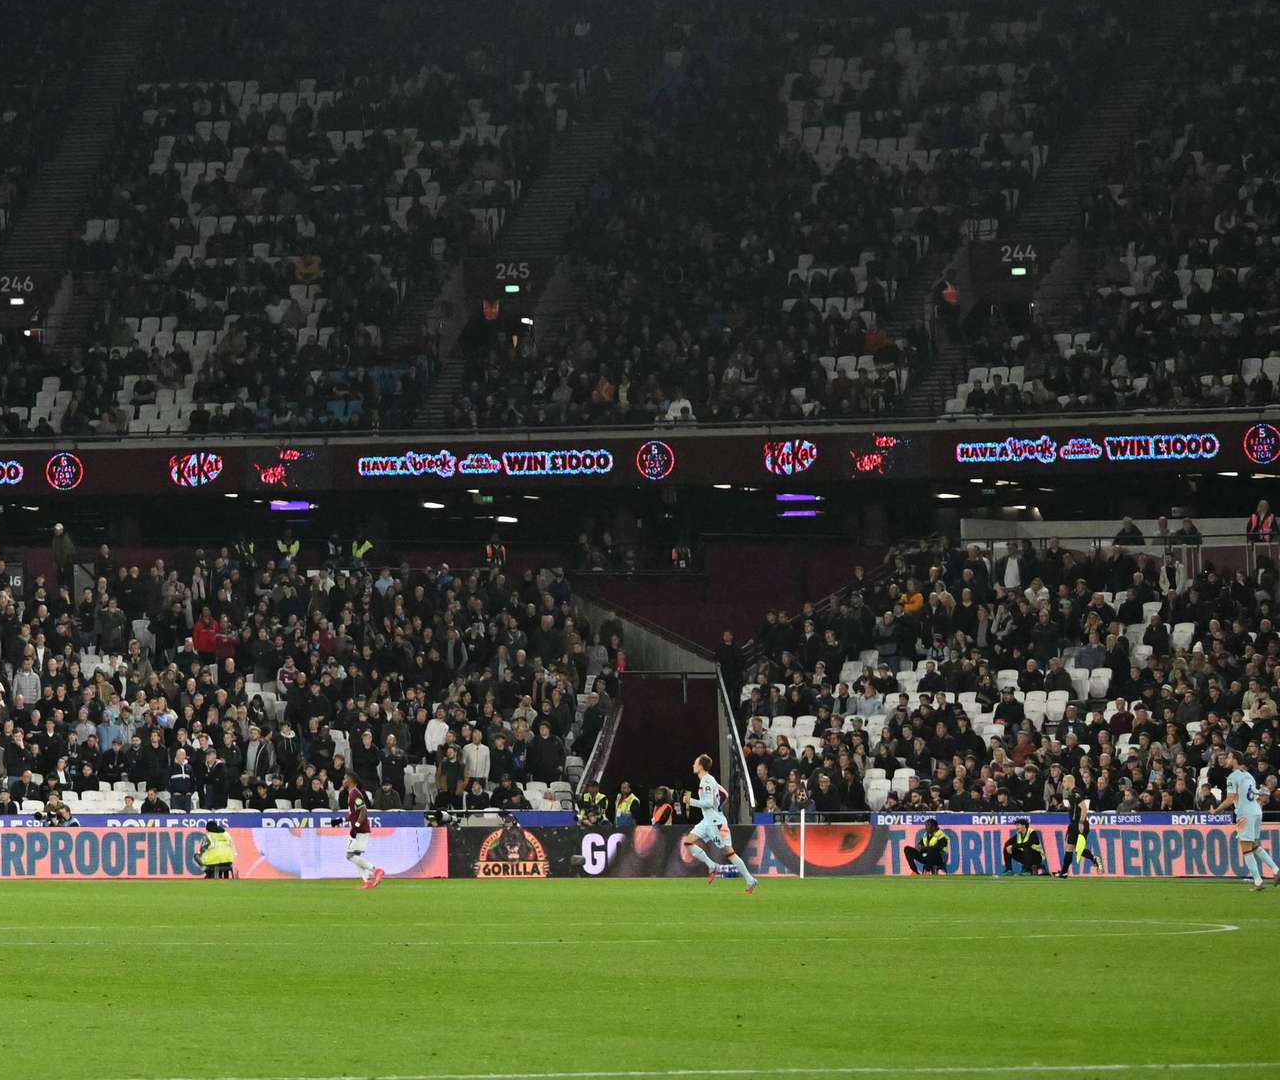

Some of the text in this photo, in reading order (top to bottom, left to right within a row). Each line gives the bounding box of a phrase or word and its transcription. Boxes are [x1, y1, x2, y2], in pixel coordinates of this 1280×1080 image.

[1000, 244, 1038, 261] 244
[495, 262, 530, 280] 245
[0, 275, 34, 292] 246
[960, 446, 996, 458] HAVE
[1010, 440, 1053, 458] break
[1108, 438, 1151, 459] WIN
[363, 459, 397, 472] HAVE
[410, 455, 453, 472] break
[507, 452, 547, 473] WIN
[877, 814, 913, 825] BOYLE
[972, 815, 1007, 825] BOYLE
[1117, 815, 1142, 823] SPORTS
[1171, 814, 1232, 825] BOYLE SPORTS
[482, 862, 541, 876] GORILLA
